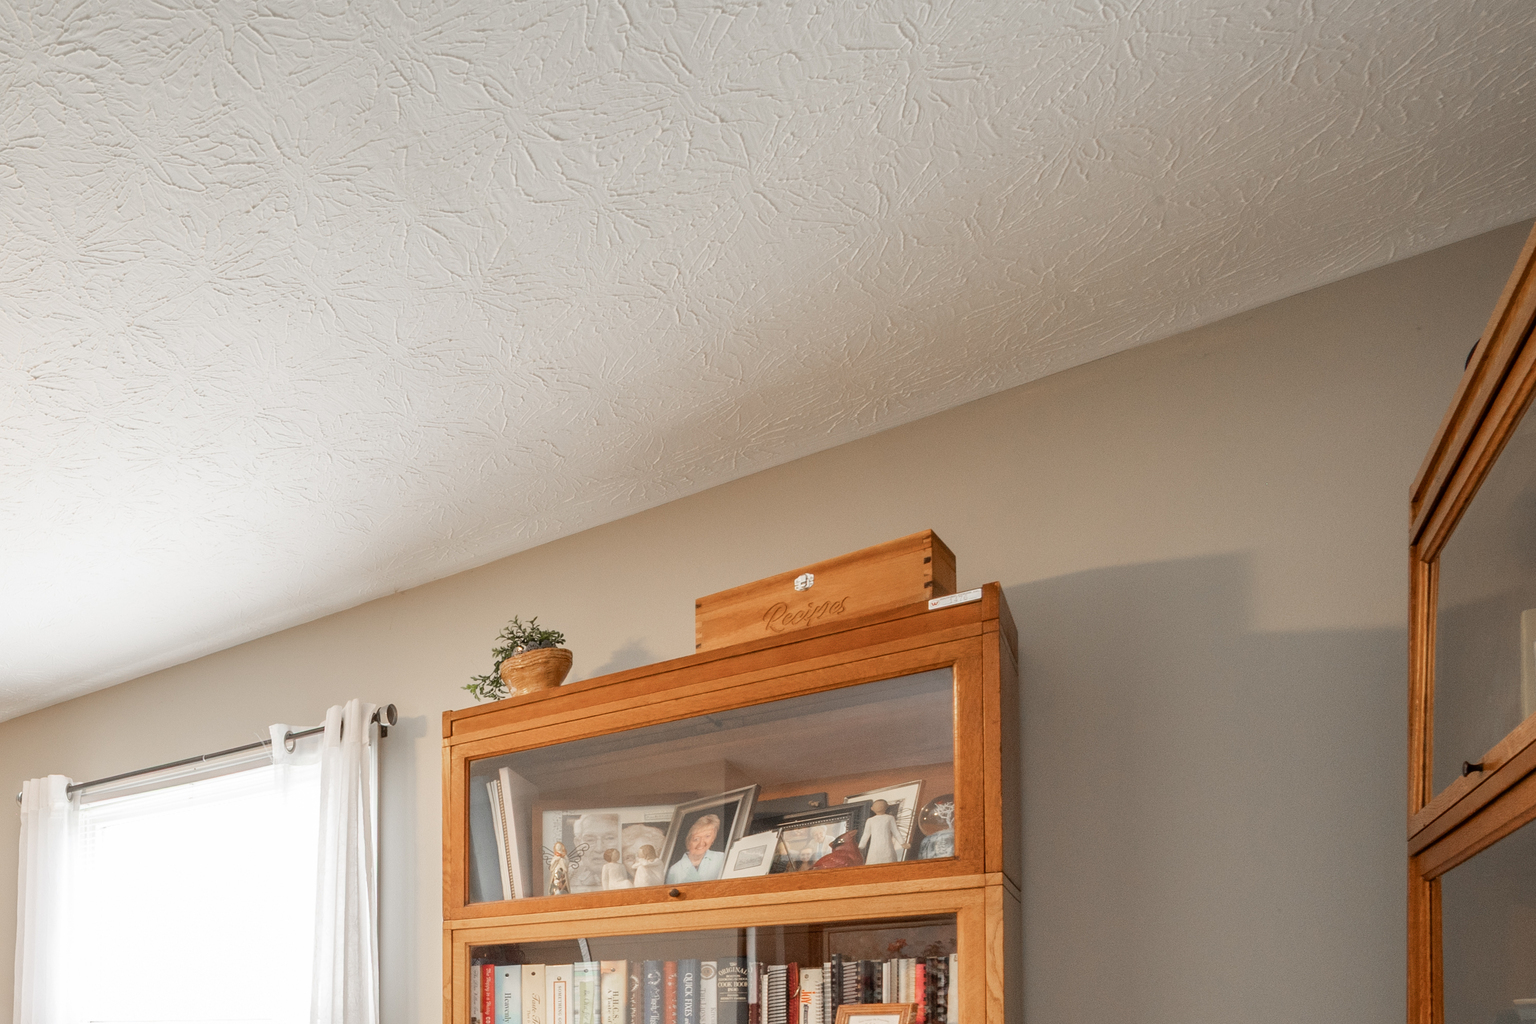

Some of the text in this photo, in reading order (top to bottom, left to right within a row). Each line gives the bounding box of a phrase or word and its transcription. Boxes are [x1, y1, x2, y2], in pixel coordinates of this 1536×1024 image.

[762, 596, 851, 633] Recipes
[718, 966, 748, 976] ORIGINAL
[683, 972, 693, 997] QUICK
[502, 992, 512, 1023] Heavenly
[684, 998, 693, 1016] FIXES
